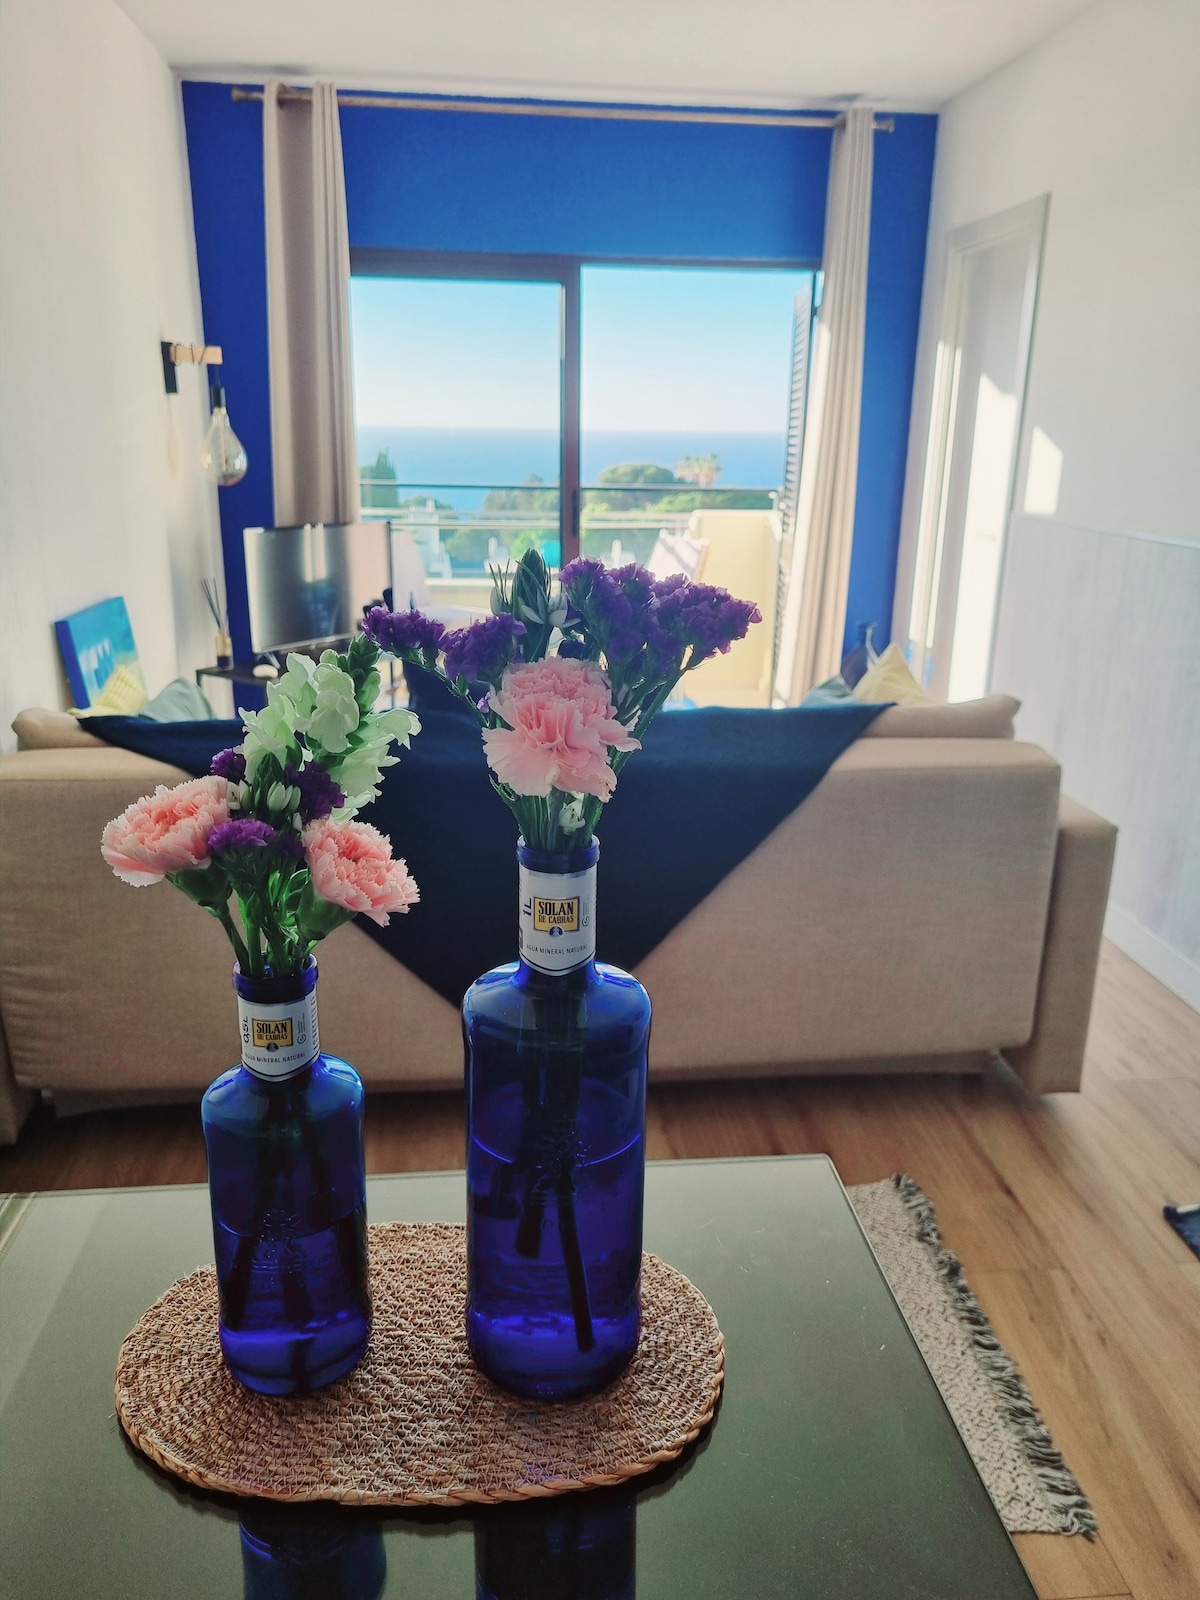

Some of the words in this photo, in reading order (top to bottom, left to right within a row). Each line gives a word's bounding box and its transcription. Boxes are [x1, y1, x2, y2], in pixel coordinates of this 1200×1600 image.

[538, 915, 546, 923] DE
[548, 916, 574, 924] CABRAS
[526, 944, 538, 952] AGUA
[282, 1052, 306, 1062] NATURAL
